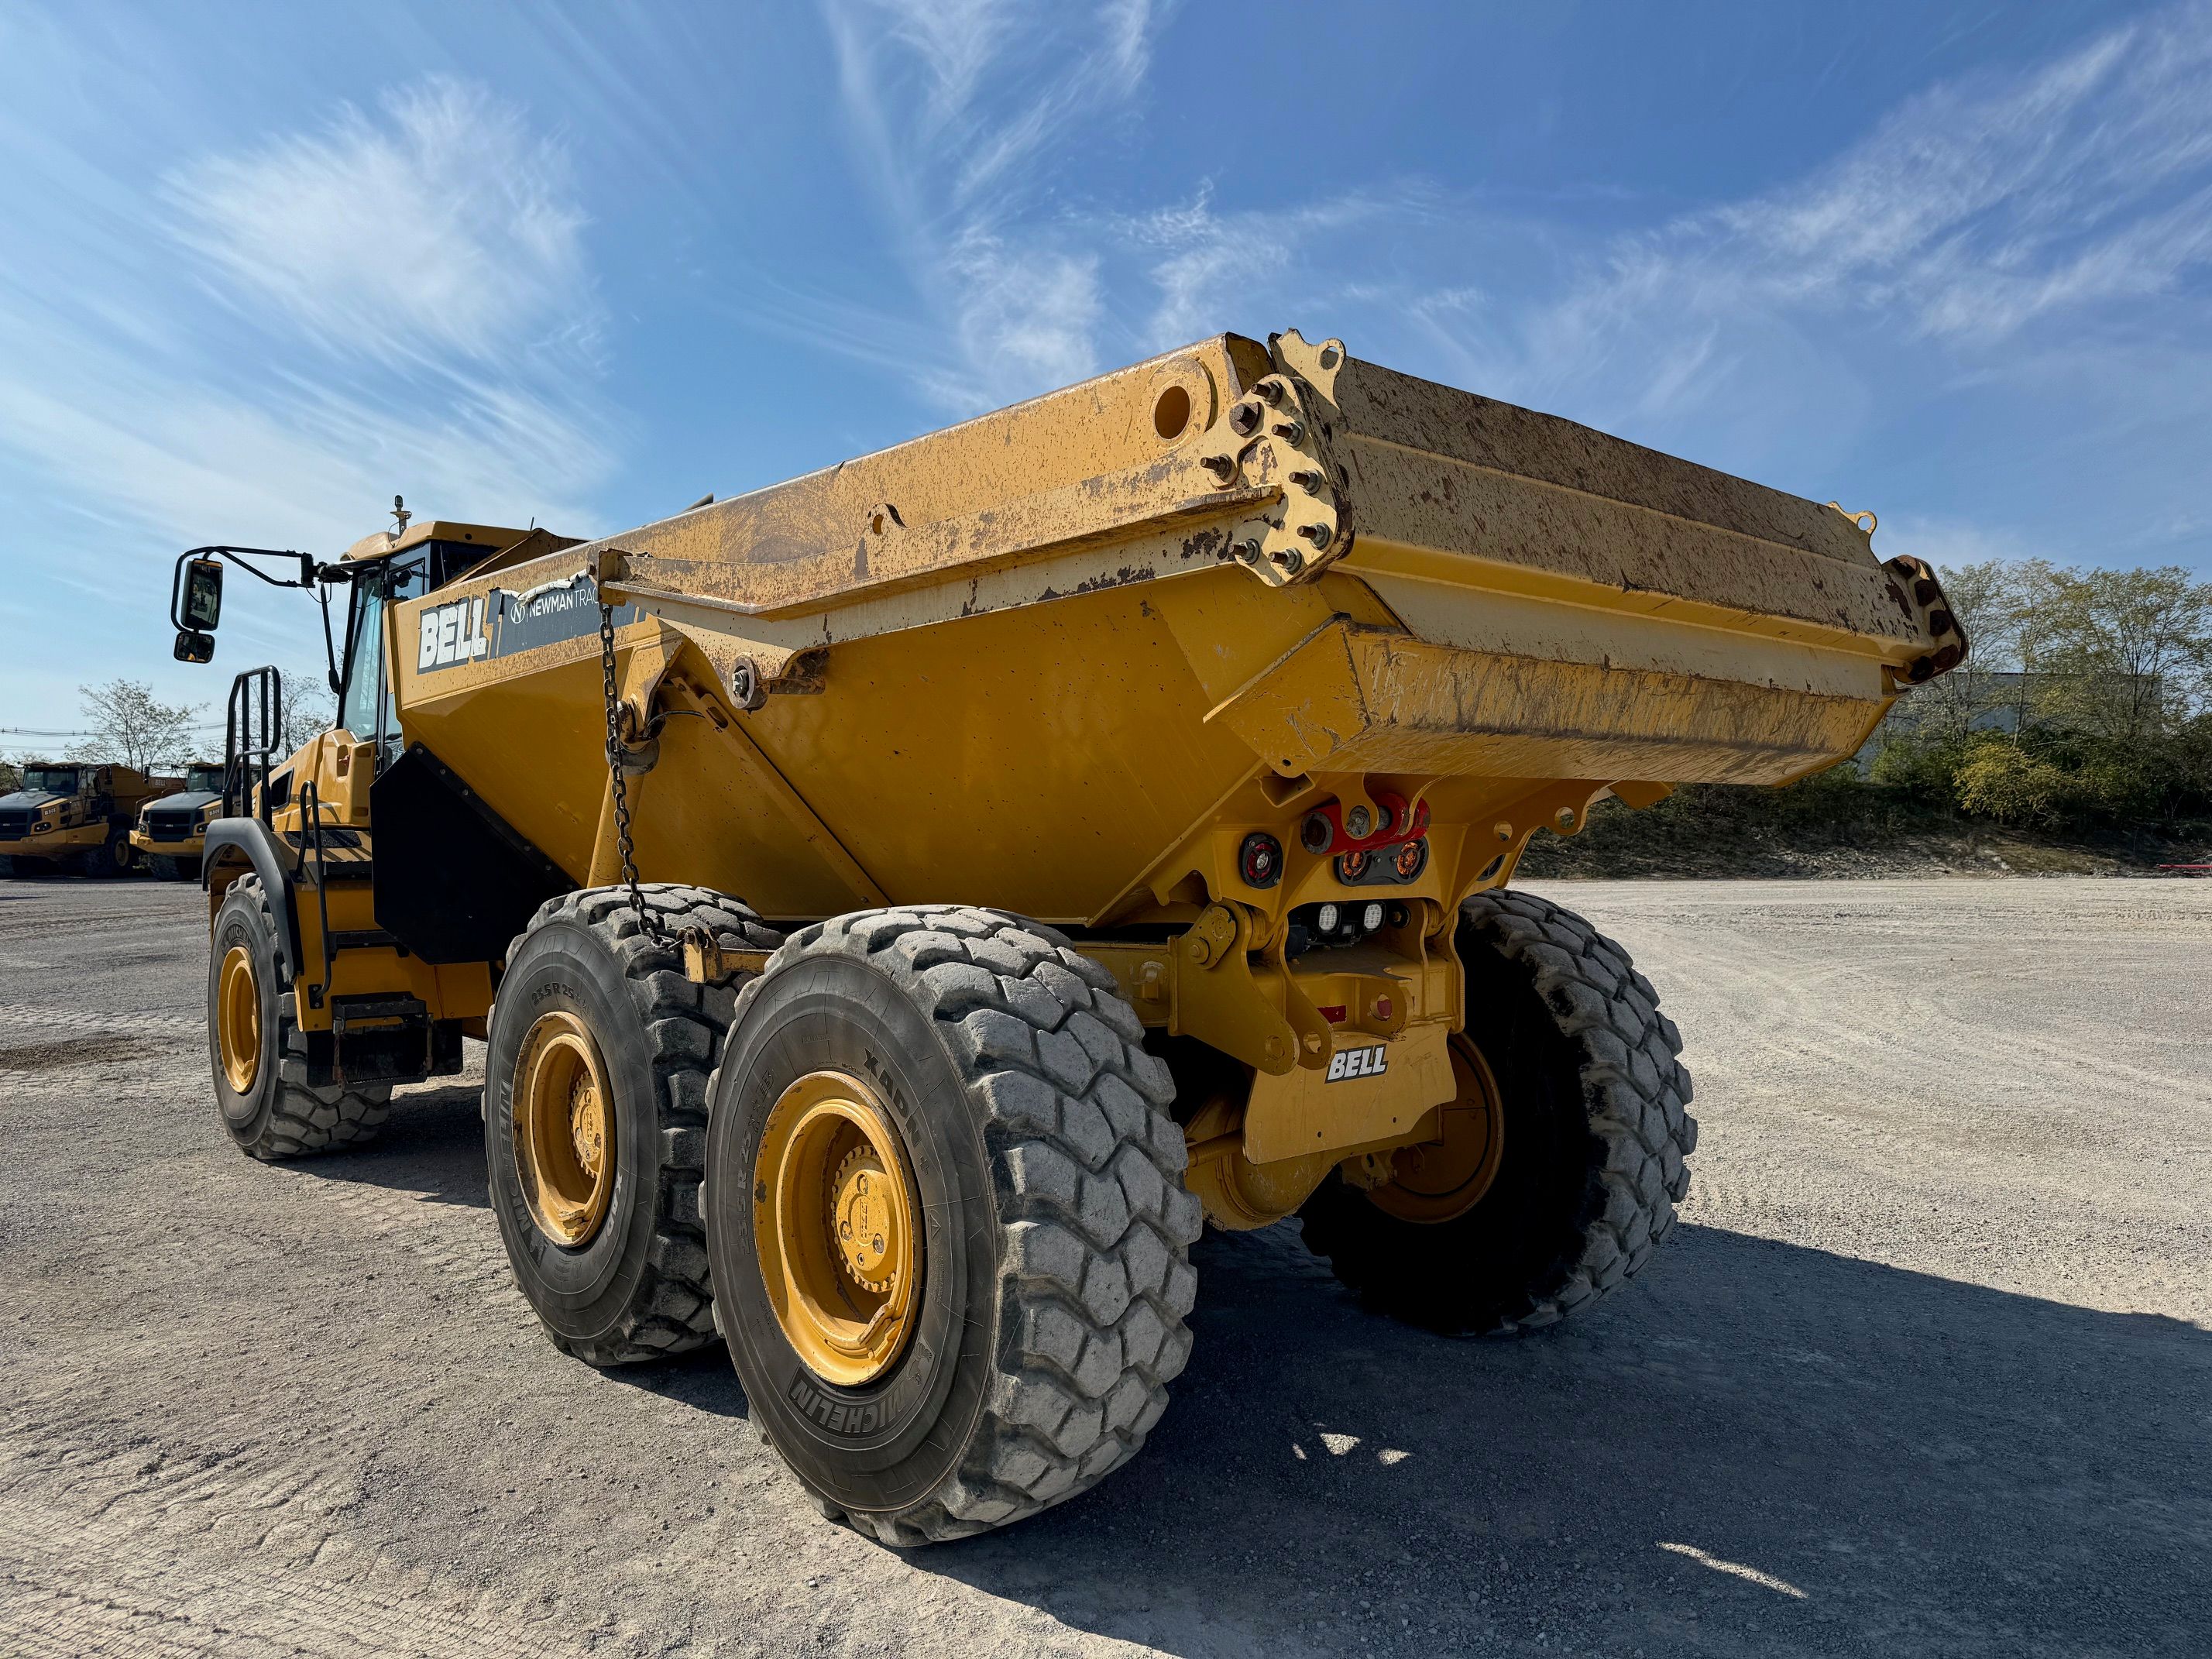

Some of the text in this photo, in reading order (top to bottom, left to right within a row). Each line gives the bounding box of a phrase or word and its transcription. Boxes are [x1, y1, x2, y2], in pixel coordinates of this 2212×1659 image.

[418, 599, 487, 669] BELL
[1327, 1046, 1386, 1080] BELL
[500, 1079, 532, 1233] MICHELIN
[791, 1378, 906, 1434] MICHELIN
